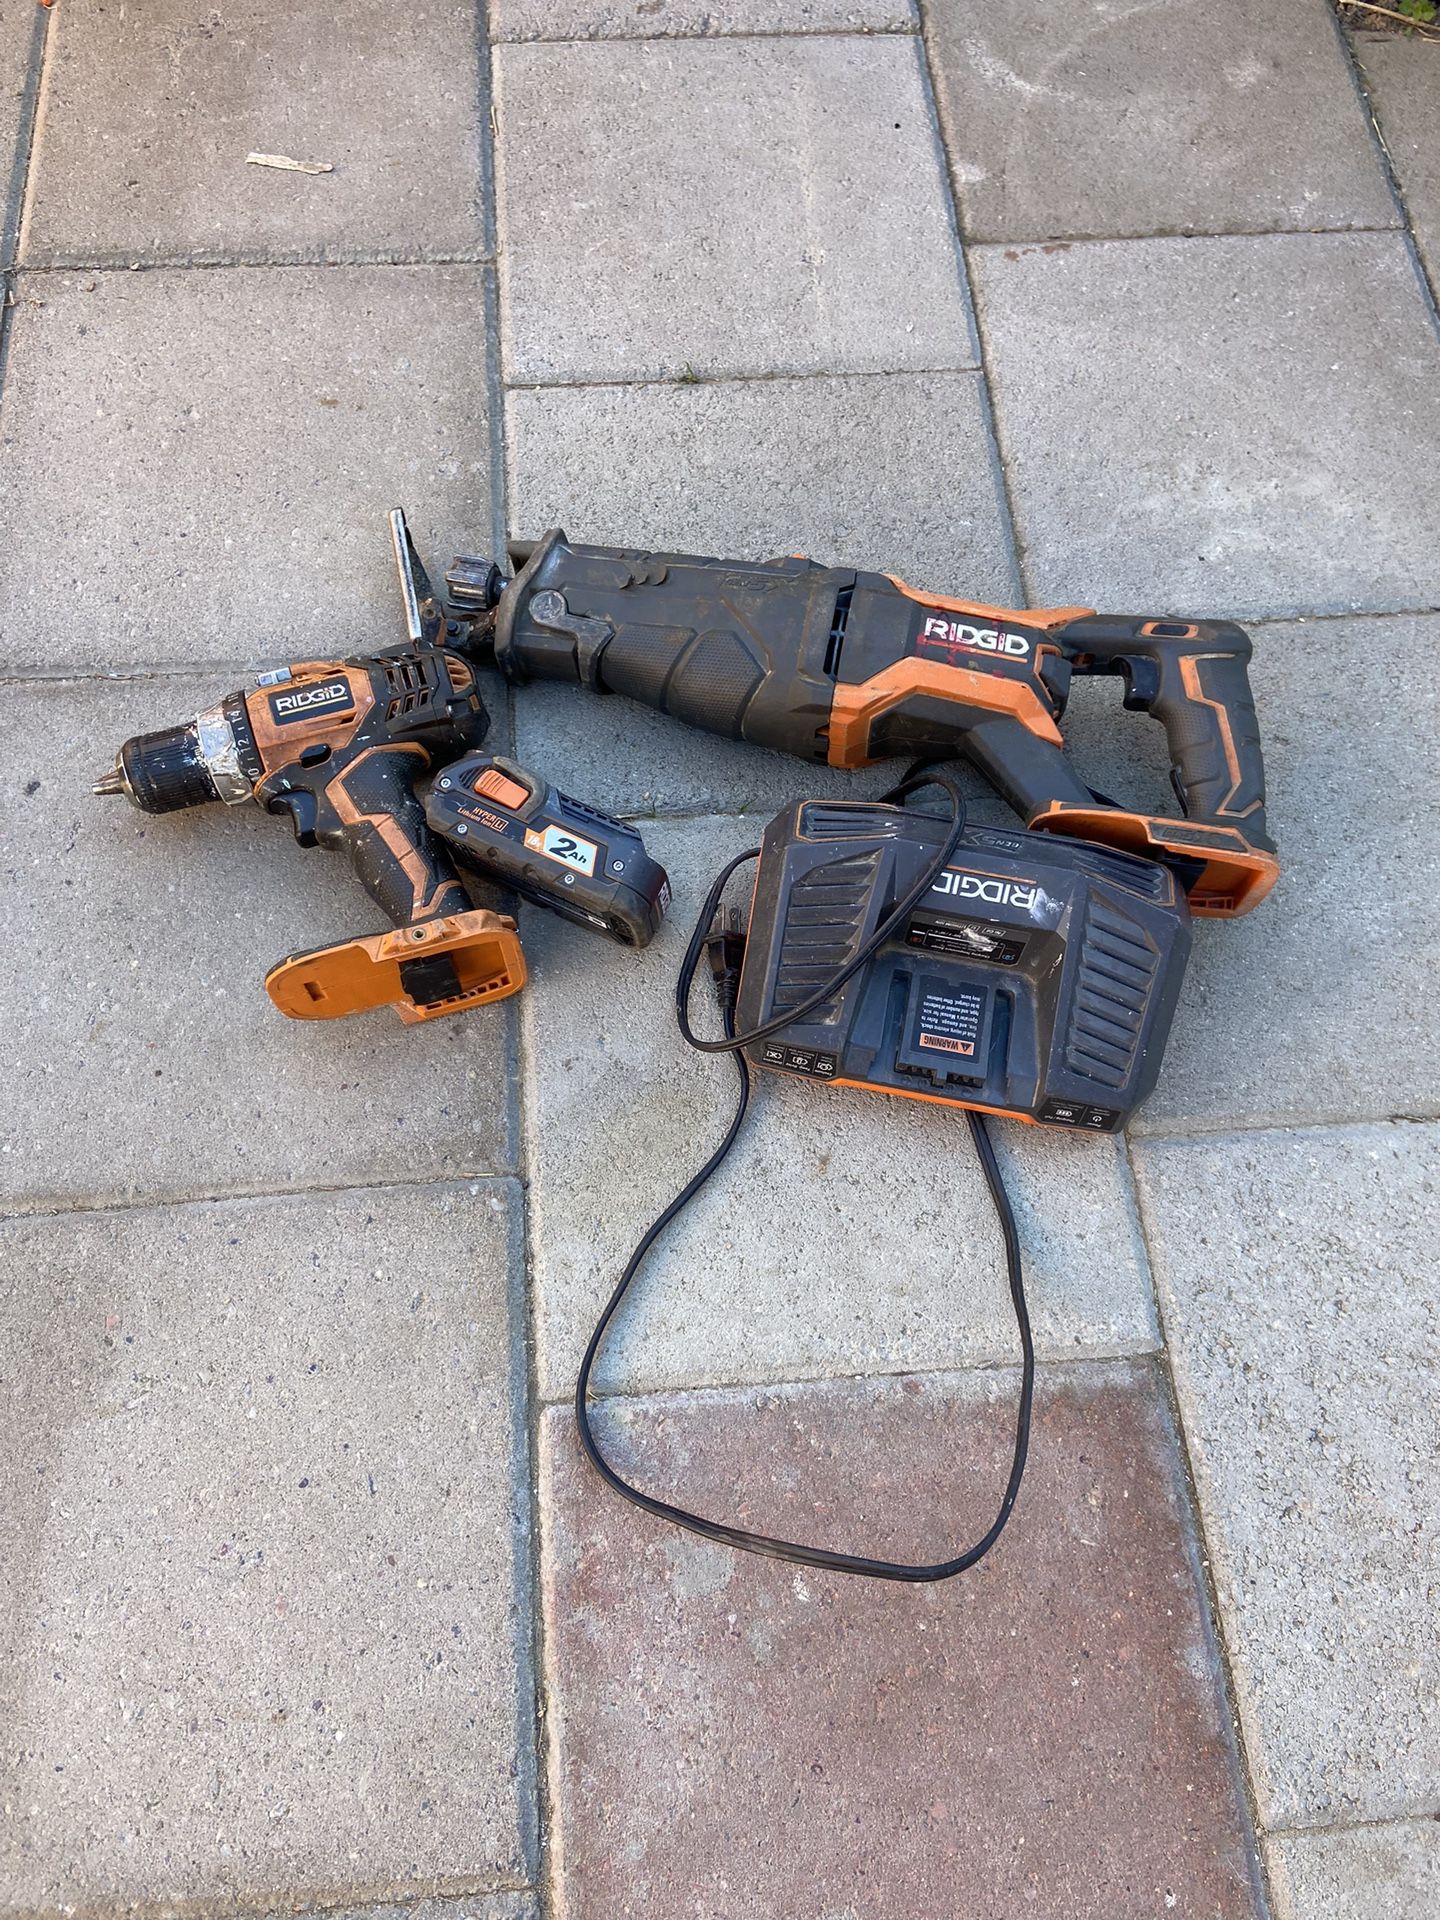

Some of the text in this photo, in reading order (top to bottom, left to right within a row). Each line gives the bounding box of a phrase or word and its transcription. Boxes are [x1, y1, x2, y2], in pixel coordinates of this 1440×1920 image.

[924, 617, 1030, 655] RIDGID
[275, 684, 346, 711] RIDGID
[457, 807, 492, 827] Lithium Ion
[472, 806, 497, 821] HYPER
[931, 872, 1036, 909] RIDGID
[923, 1001, 941, 1009] batteries
[923, 1035, 959, 1050] WARNING
